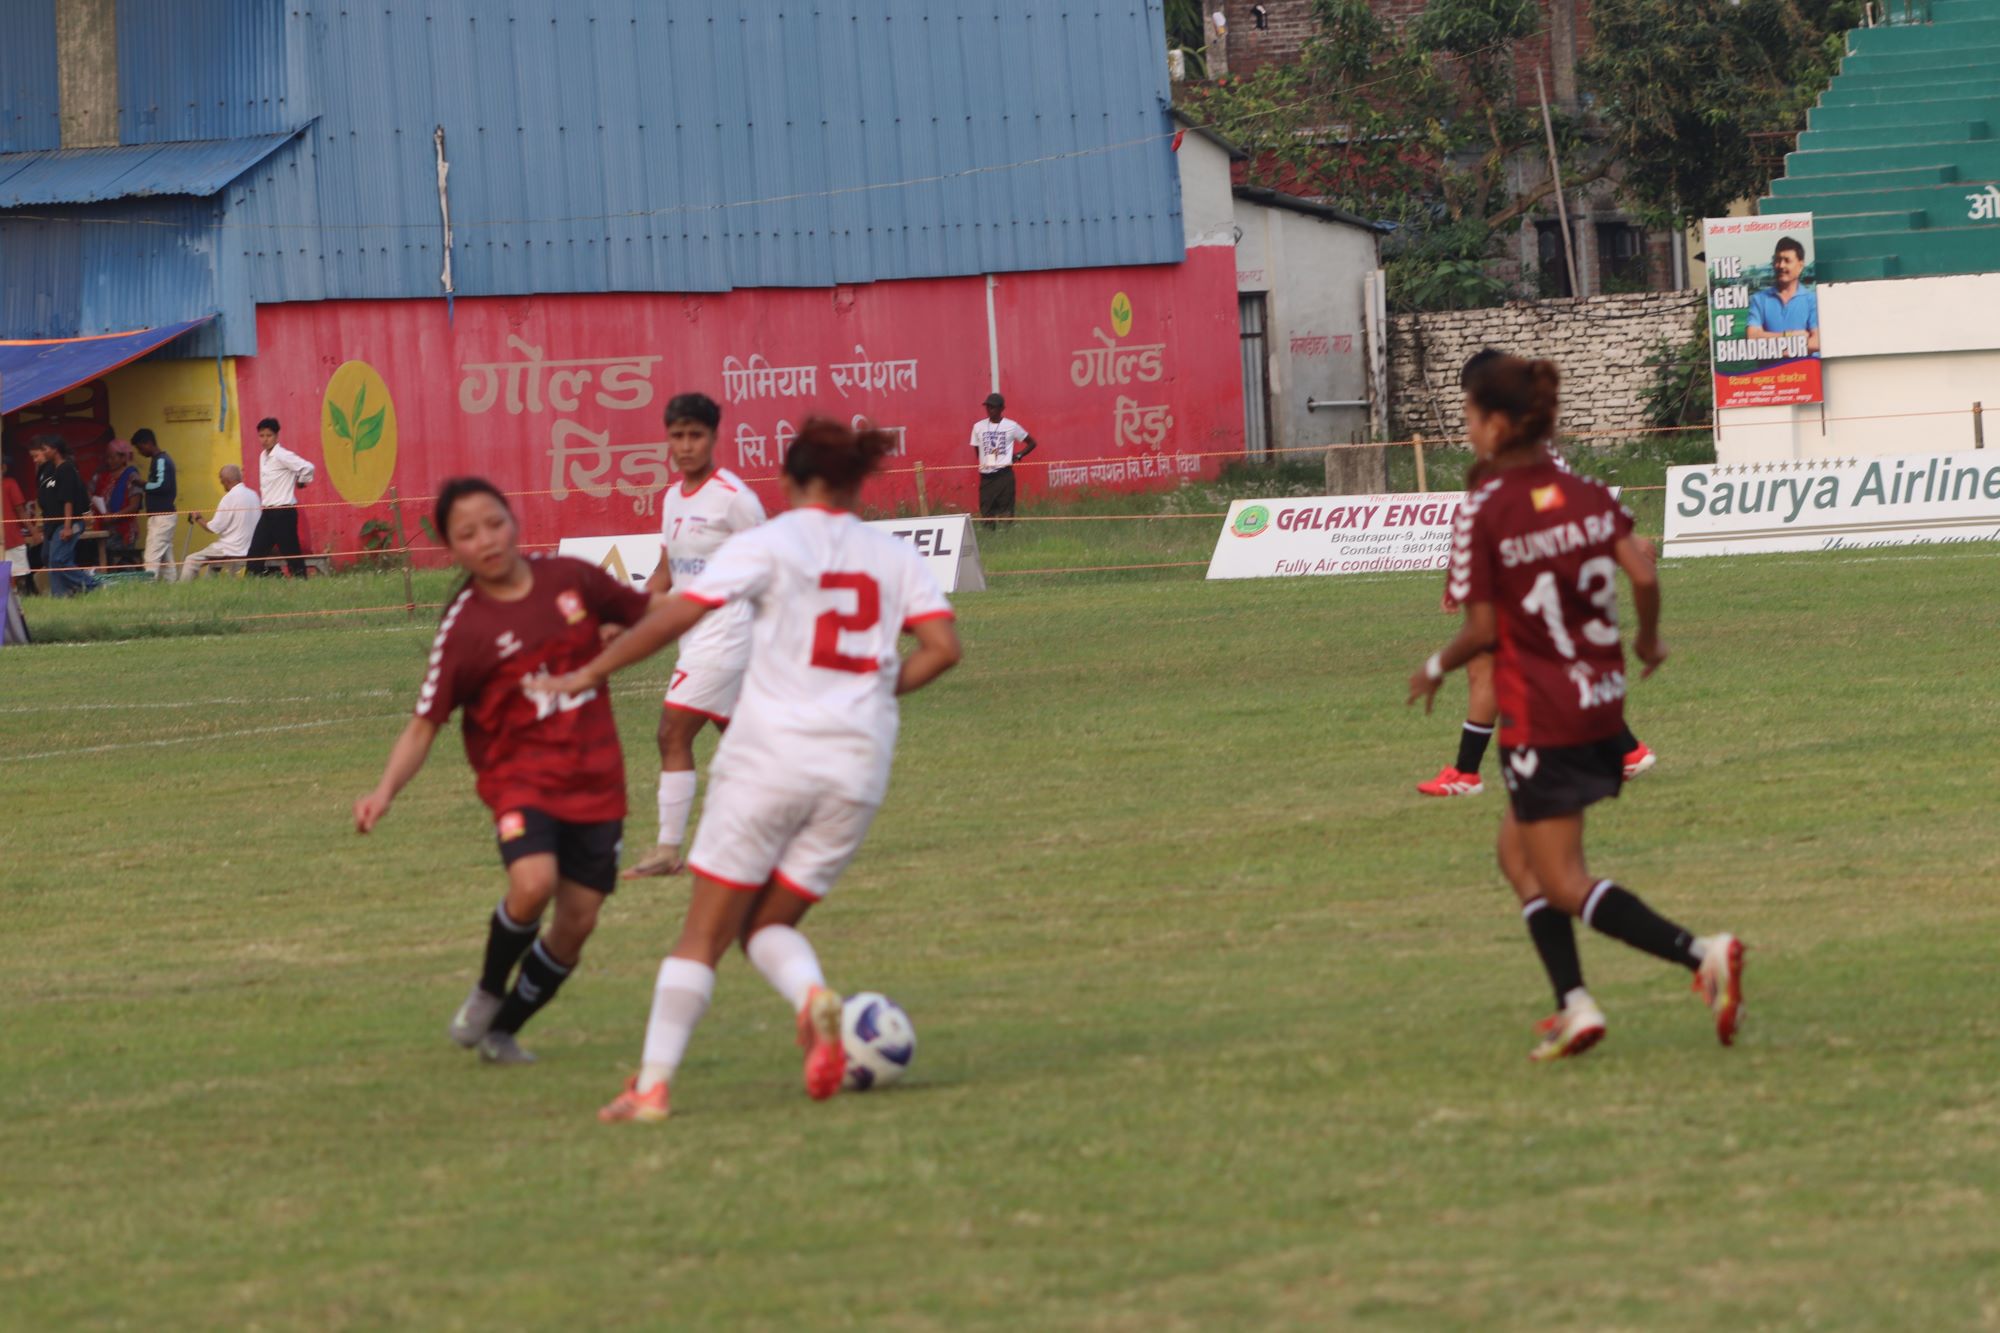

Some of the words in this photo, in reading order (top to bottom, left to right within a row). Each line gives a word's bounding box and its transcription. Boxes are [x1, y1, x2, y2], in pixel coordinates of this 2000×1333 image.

[1713, 256, 1741, 279] THE
[1714, 285, 1749, 309] GEM
[1716, 314, 1734, 337] OF
[1071, 326, 1167, 387] गोल्ड
[1717, 335, 1809, 362] BHADRAPUR
[458, 334, 663, 414] गोल्ड
[722, 353, 817, 404] प्रिमियम
[830, 344, 918, 398] स्पेशल
[1677, 472, 1839, 523] Saurya
[1276, 505, 1379, 532] GALAXY
[1331, 532, 1416, 545] Bhadrapur-9,
[1340, 545, 1391, 555] Contact
[1275, 559, 1312, 576] Fully
[1314, 558, 1337, 572] Air
[1340, 555, 1434, 571] conditioned
[1522, 555, 1619, 658] 13
[810, 571, 880, 674] 2
[671, 669, 688, 690] 7
